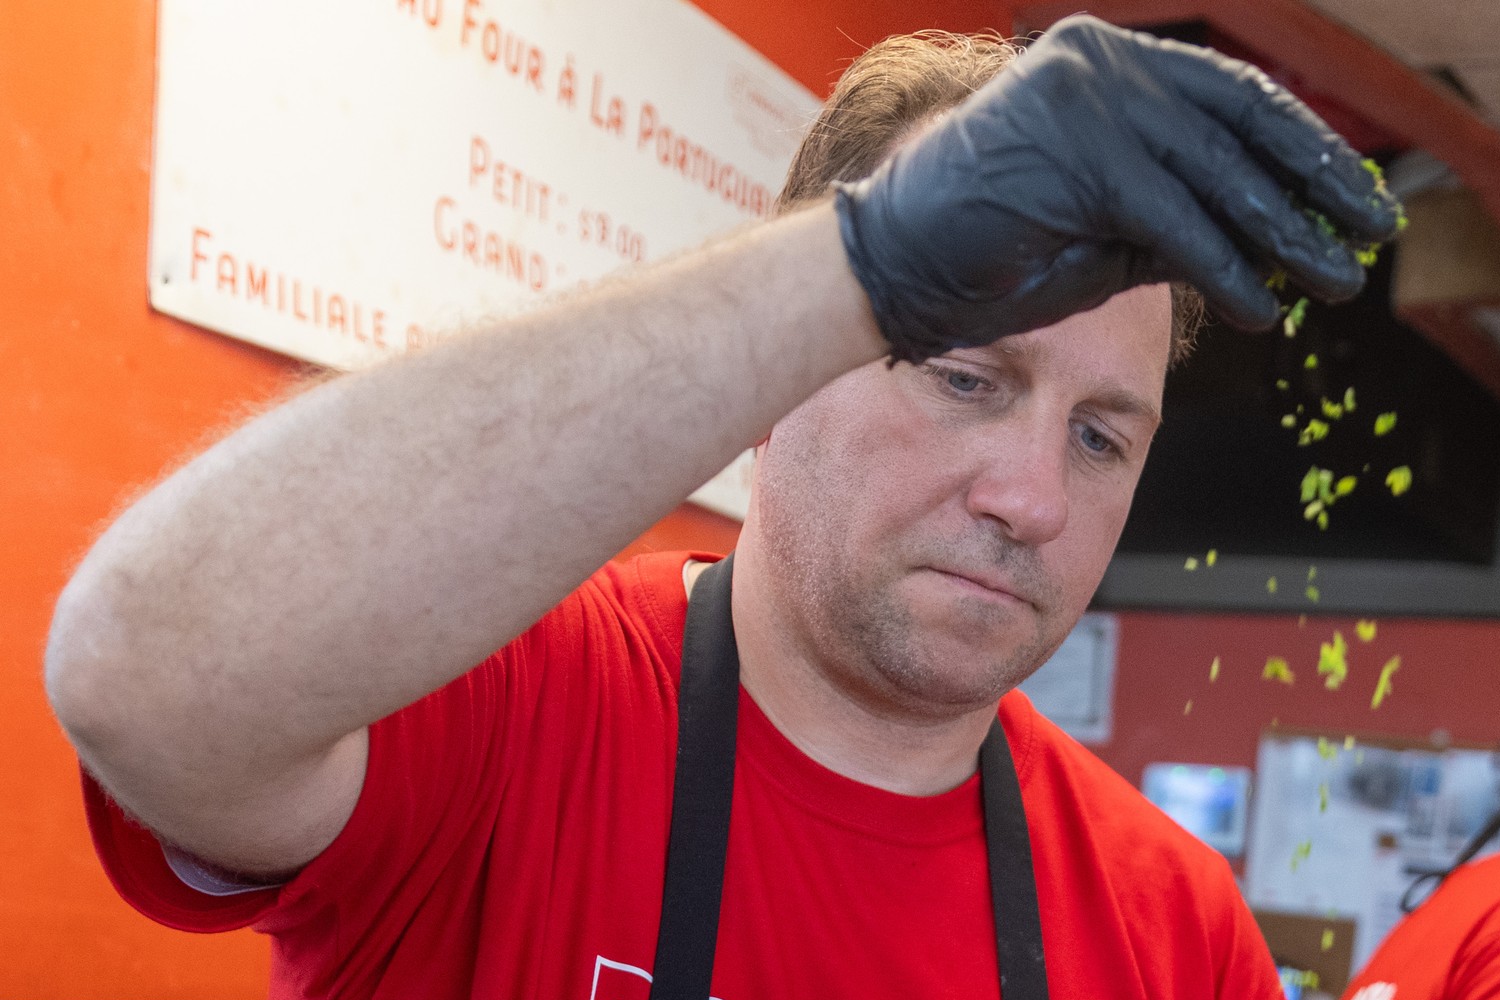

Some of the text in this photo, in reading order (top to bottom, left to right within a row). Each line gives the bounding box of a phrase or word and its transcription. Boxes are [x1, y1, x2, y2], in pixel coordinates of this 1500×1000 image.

[459, 0, 543, 94] FOUR
[590, 72, 624, 136] LA
[190, 226, 388, 350] FAMILIALE
